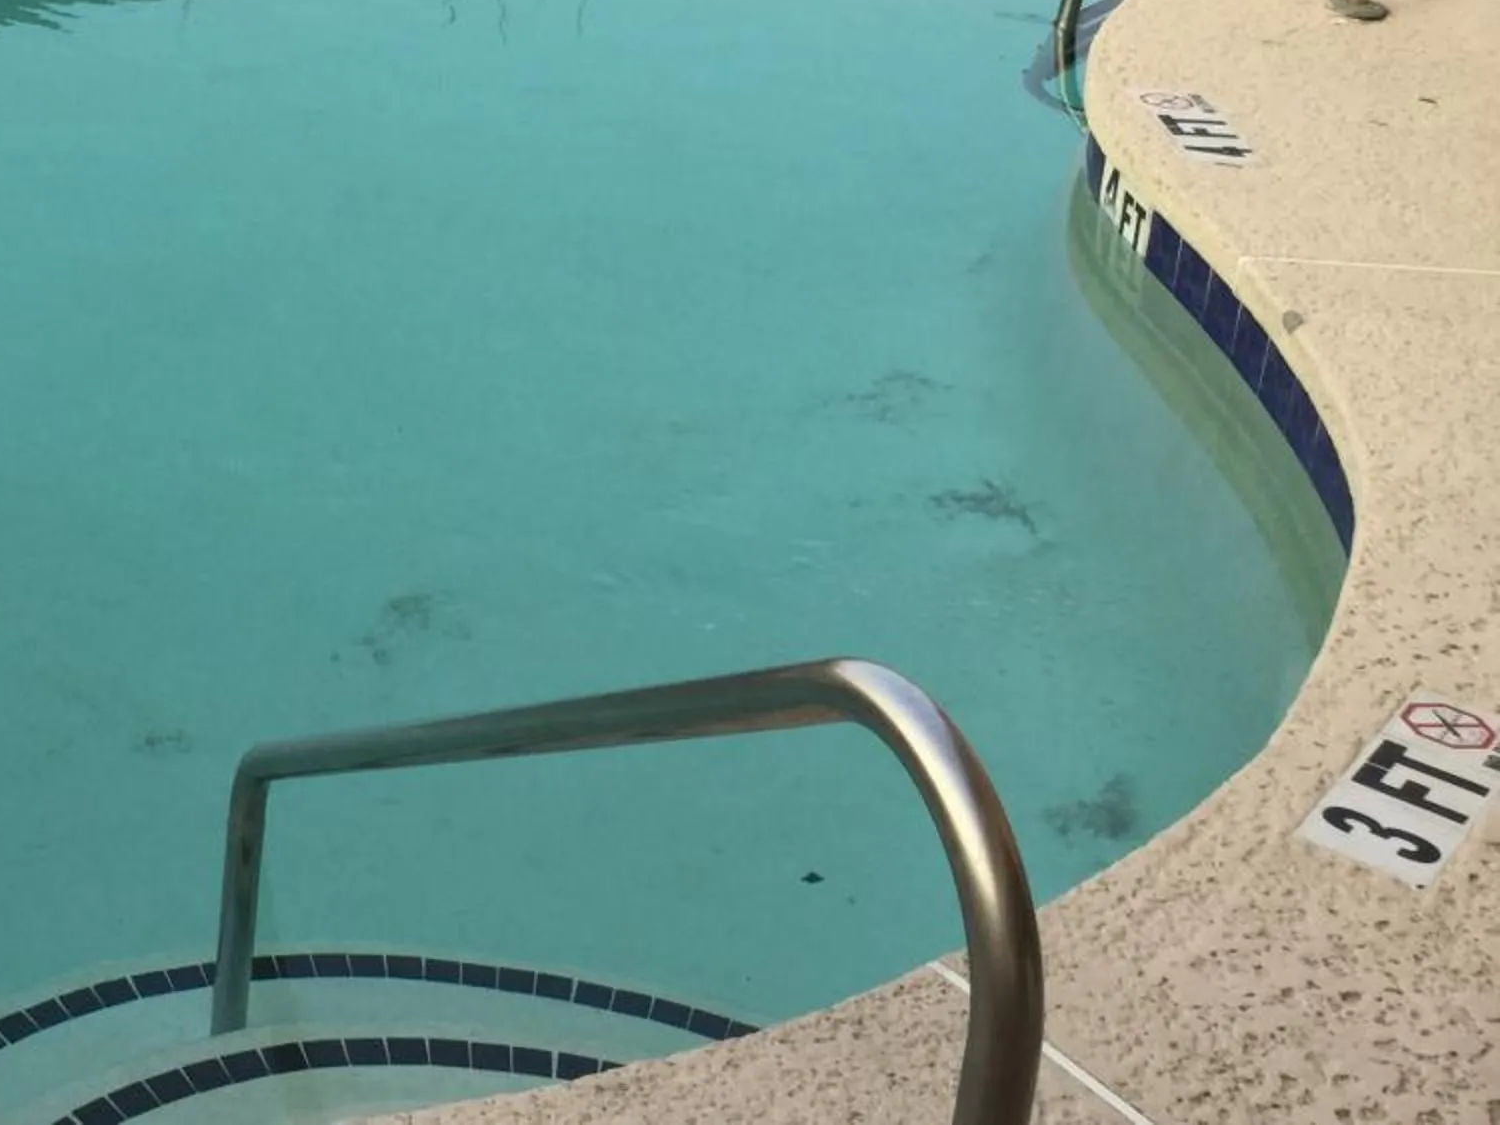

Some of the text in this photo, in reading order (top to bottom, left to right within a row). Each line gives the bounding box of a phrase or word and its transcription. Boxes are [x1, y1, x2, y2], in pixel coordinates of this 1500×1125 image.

[1119, 191, 1147, 251] FT
[1322, 739, 1490, 864] 3 FT
